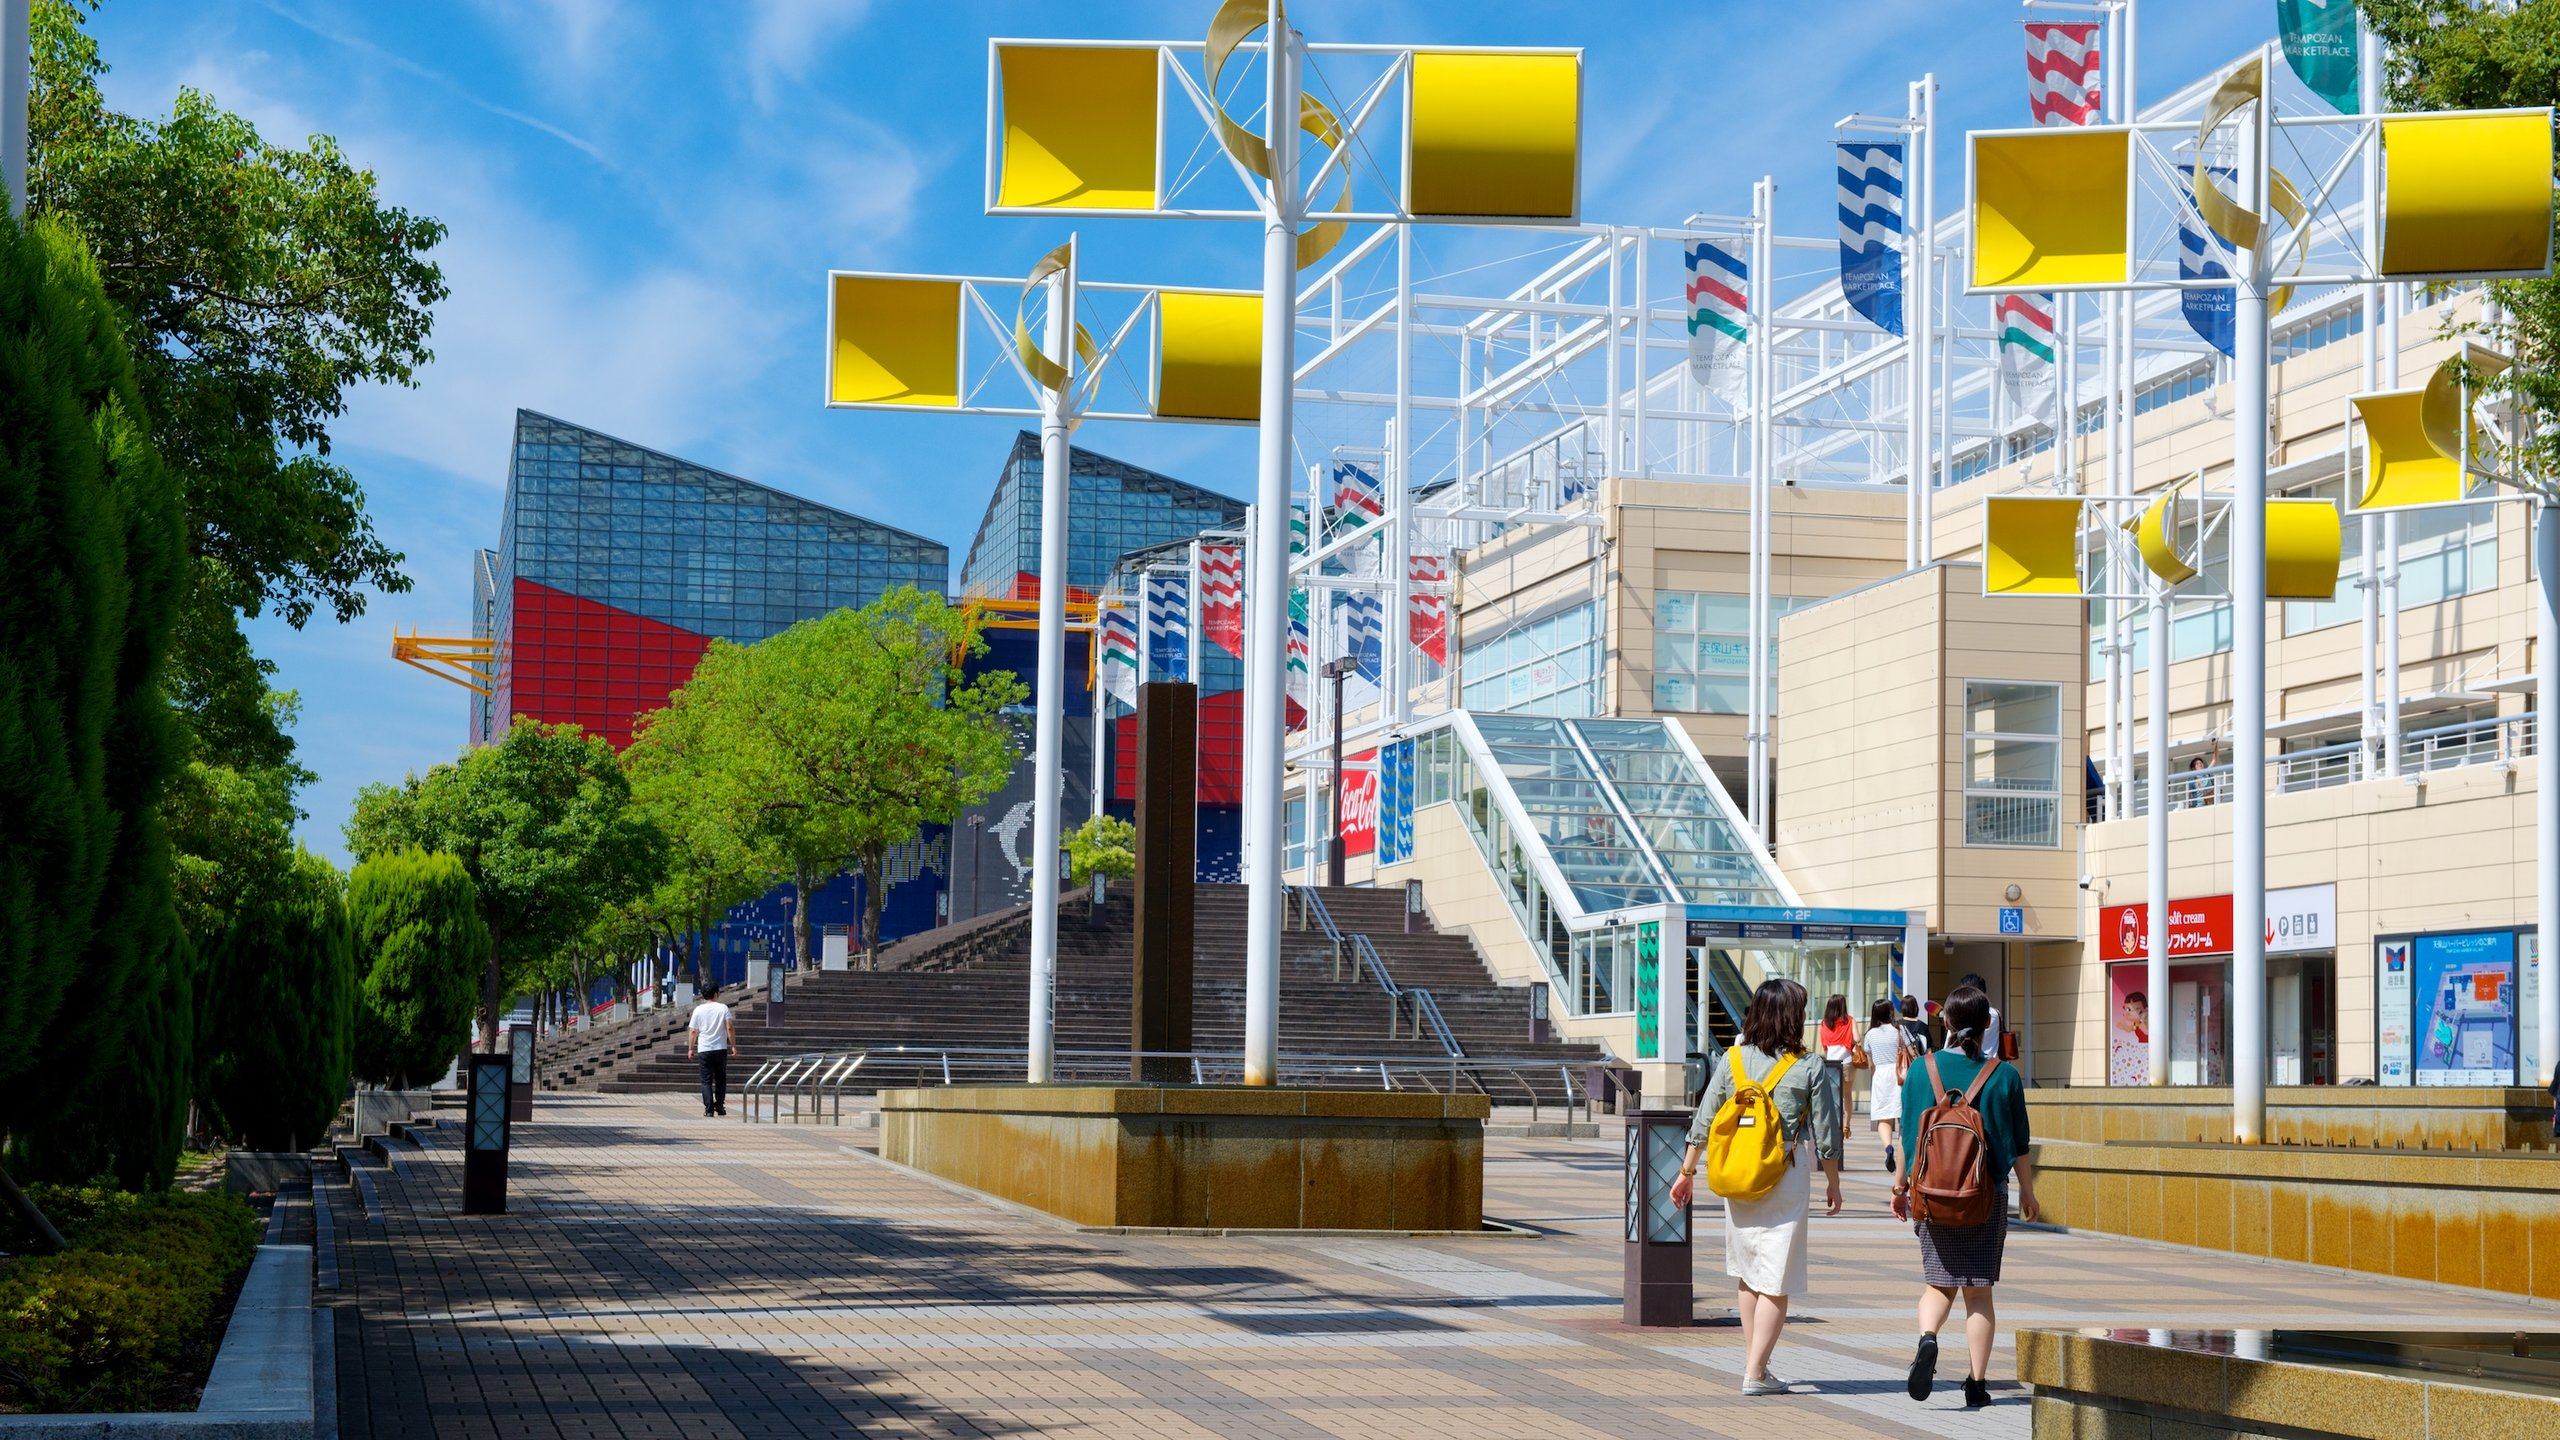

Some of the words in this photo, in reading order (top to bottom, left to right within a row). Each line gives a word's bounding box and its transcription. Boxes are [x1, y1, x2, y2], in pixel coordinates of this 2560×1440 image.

[2289, 32, 2343, 44] TEMPOZAN
[2284, 45, 2351, 57] MARKETPLACE
[1845, 272, 1889, 281] TEMPOZAN
[2183, 292, 2225, 302] TEMPOZAN
[1795, 910, 1811, 920] 2F
[2182, 912, 2205, 925] cream
